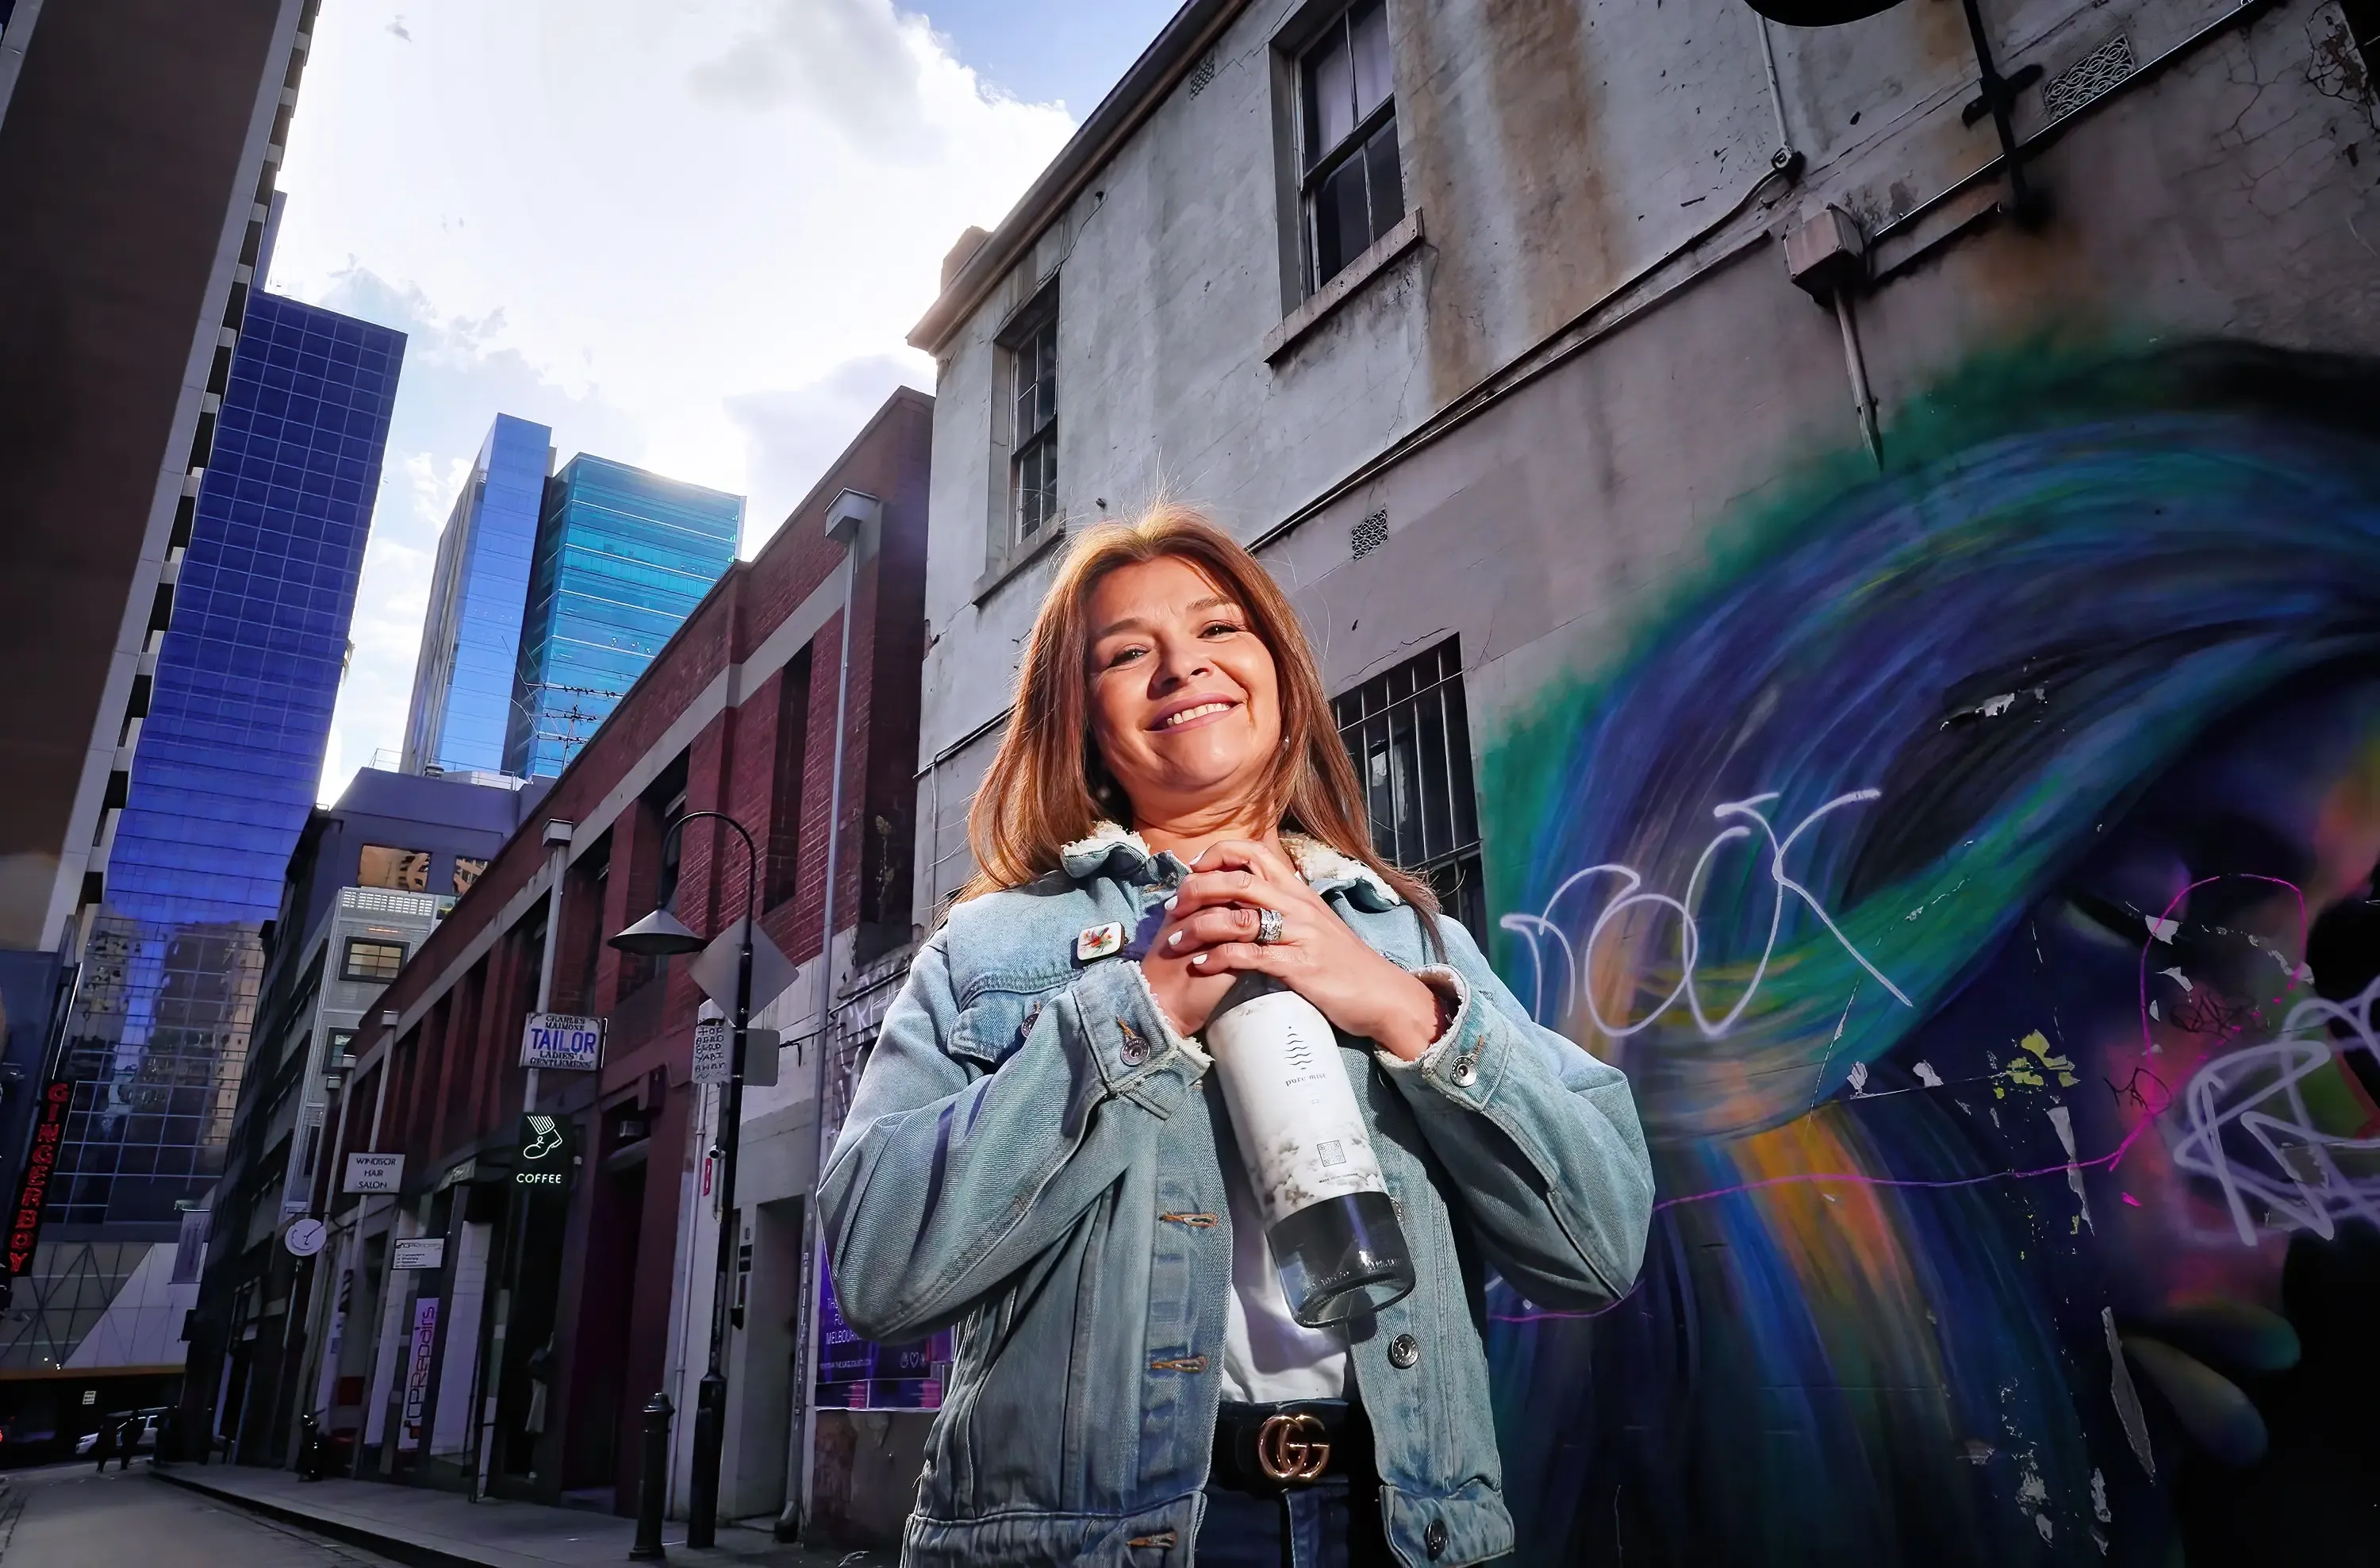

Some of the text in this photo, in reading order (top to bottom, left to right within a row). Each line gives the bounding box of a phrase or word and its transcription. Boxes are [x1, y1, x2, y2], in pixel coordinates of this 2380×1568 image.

[531, 1028, 597, 1054] TAILOR
[1285, 1075, 1306, 1086] pure
[10, 1082, 70, 1274] GINGERBOY
[516, 1173, 562, 1184] COFFEE
